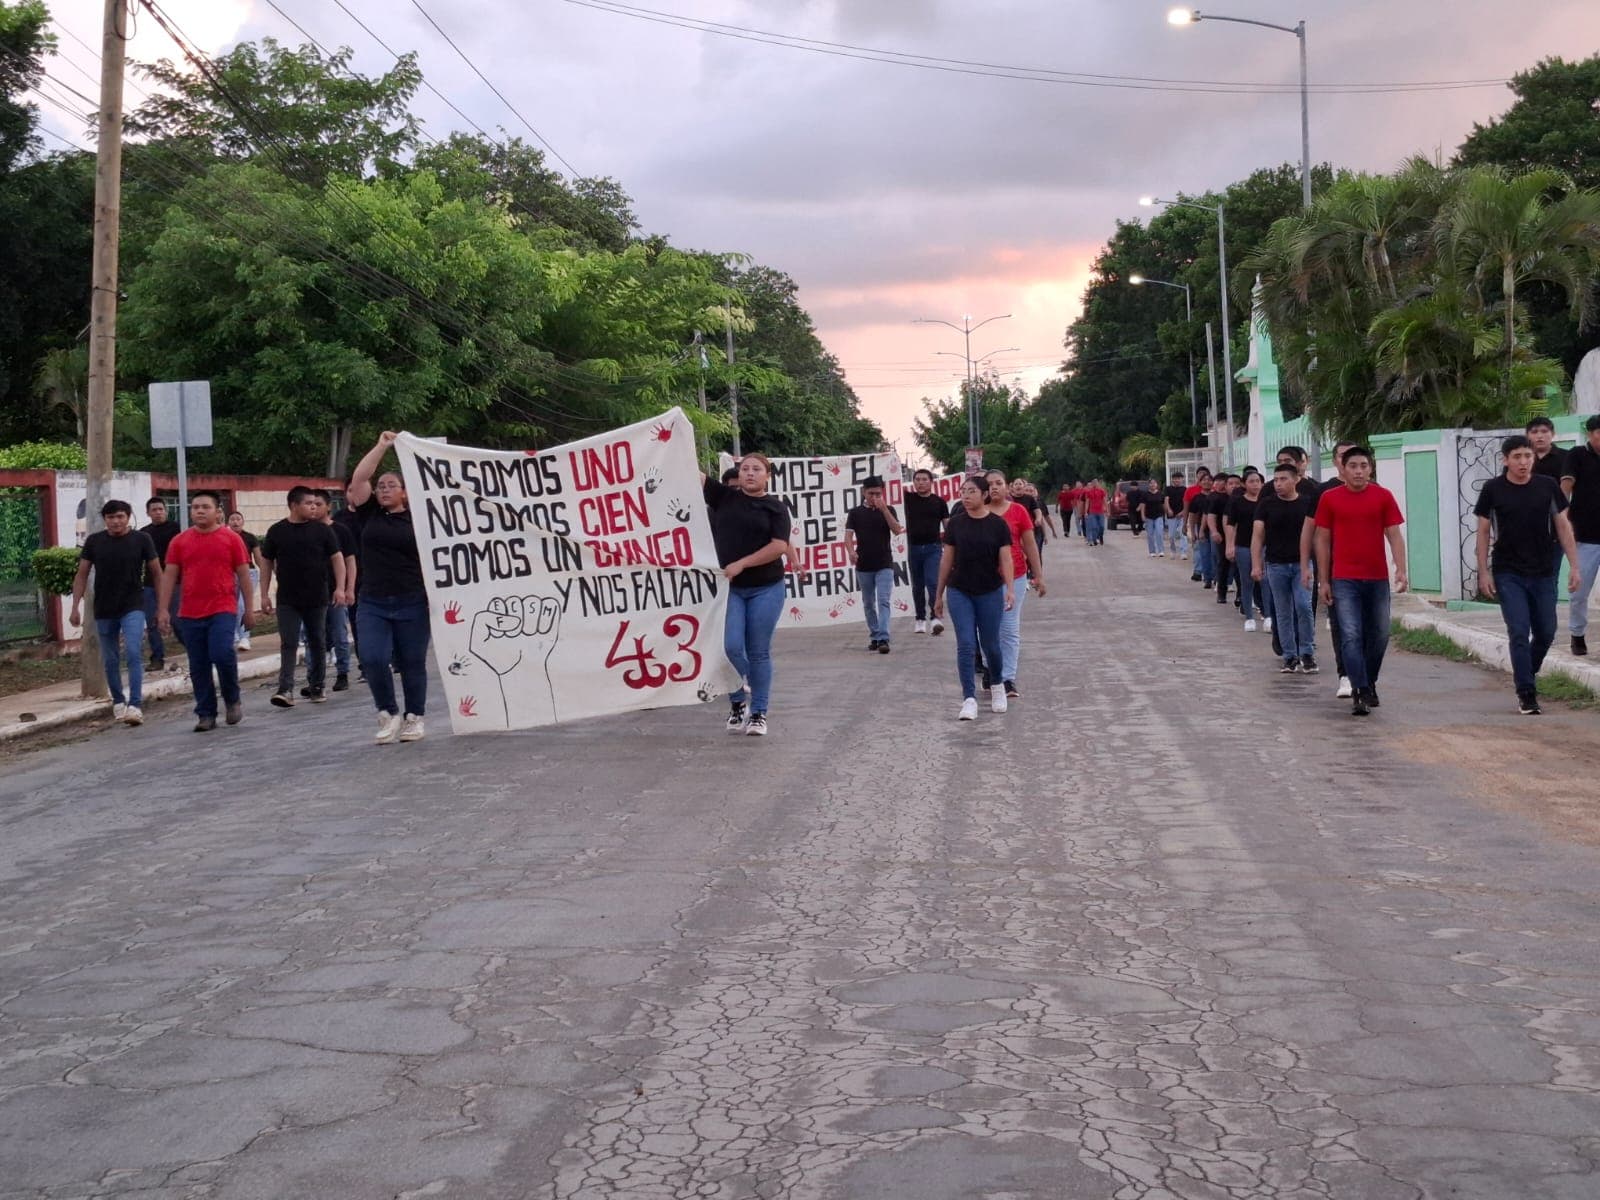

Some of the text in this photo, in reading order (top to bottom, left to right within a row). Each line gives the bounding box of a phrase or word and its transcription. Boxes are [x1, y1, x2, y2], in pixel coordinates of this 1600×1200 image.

[461, 455, 562, 498] SOMOS
[569, 441, 634, 491] UNO
[765, 460, 824, 492] MOS
[426, 487, 650, 539] NO SOMOS CIEN
[804, 517, 837, 545] DE
[432, 538, 531, 588] SOMOS
[542, 536, 582, 573] UN
[553, 567, 718, 617] Y NOS FALTAN
[605, 613, 702, 689] 43
